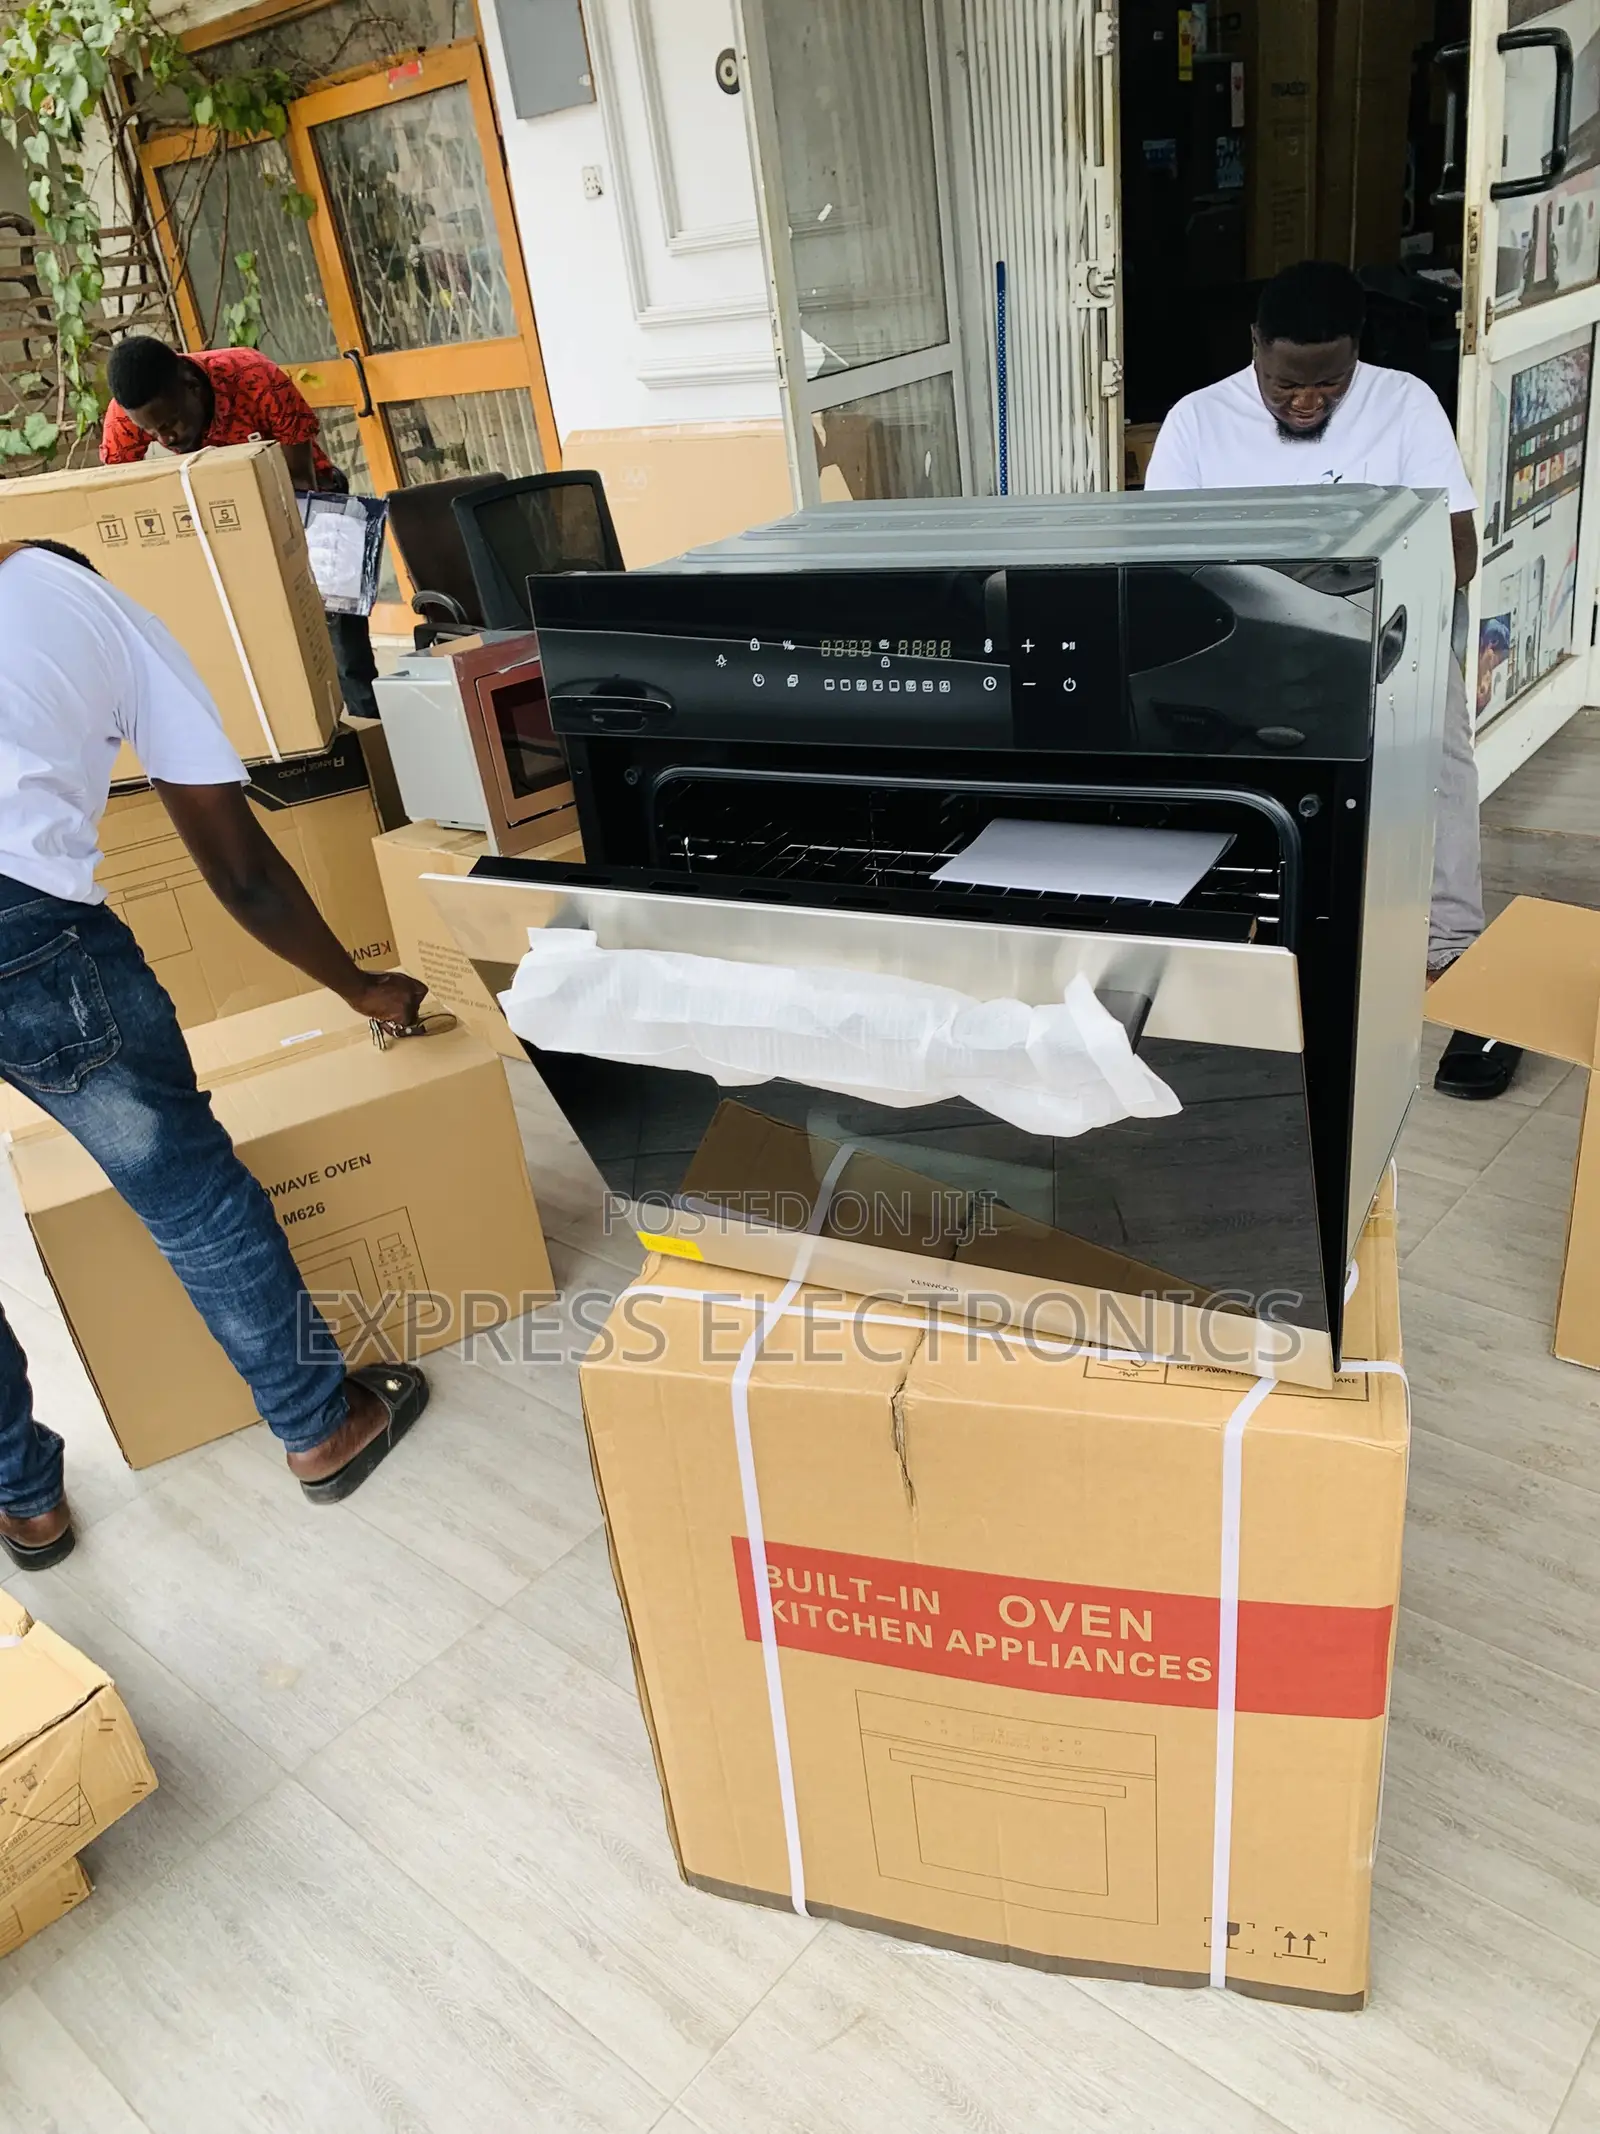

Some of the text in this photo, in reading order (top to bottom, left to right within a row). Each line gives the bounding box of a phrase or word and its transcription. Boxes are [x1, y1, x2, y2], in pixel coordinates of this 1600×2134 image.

[323, 1153, 373, 1179] OVEN
[282, 1201, 326, 1226] M626
[910, 1278, 959, 1293] KENWOOD
[998, 1594, 1153, 1643] OVEN
[771, 1599, 1213, 1682] KITCHEN APPLIANCES
